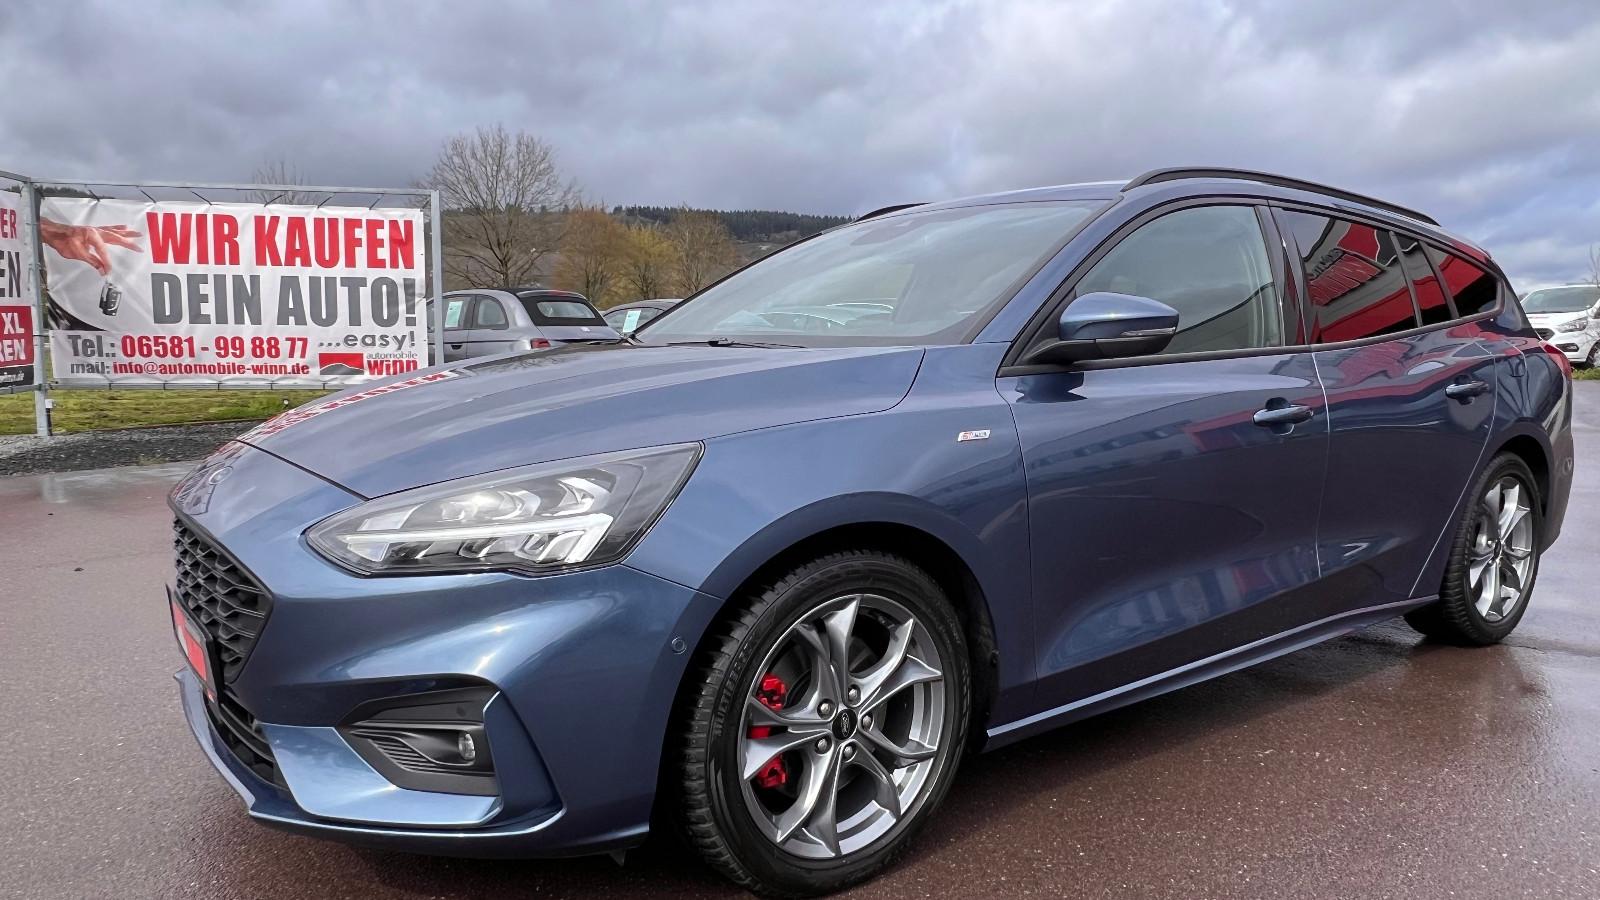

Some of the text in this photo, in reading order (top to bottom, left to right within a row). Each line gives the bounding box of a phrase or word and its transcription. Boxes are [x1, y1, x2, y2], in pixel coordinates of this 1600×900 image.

[146, 211, 415, 270] WIR KAUFEN
[151, 272, 417, 328] DEIN AUTO!
[1, 312, 25, 335] XL
[67, 334, 117, 358] Tel.:
[121, 335, 196, 359] 06581
[214, 336, 245, 359] 99
[250, 336, 281, 359] 88
[284, 336, 309, 359] 77
[318, 330, 416, 351] ...easy!
[366, 351, 418, 360] automobile
[70, 361, 310, 375] mail: info@automobile-winn.de
